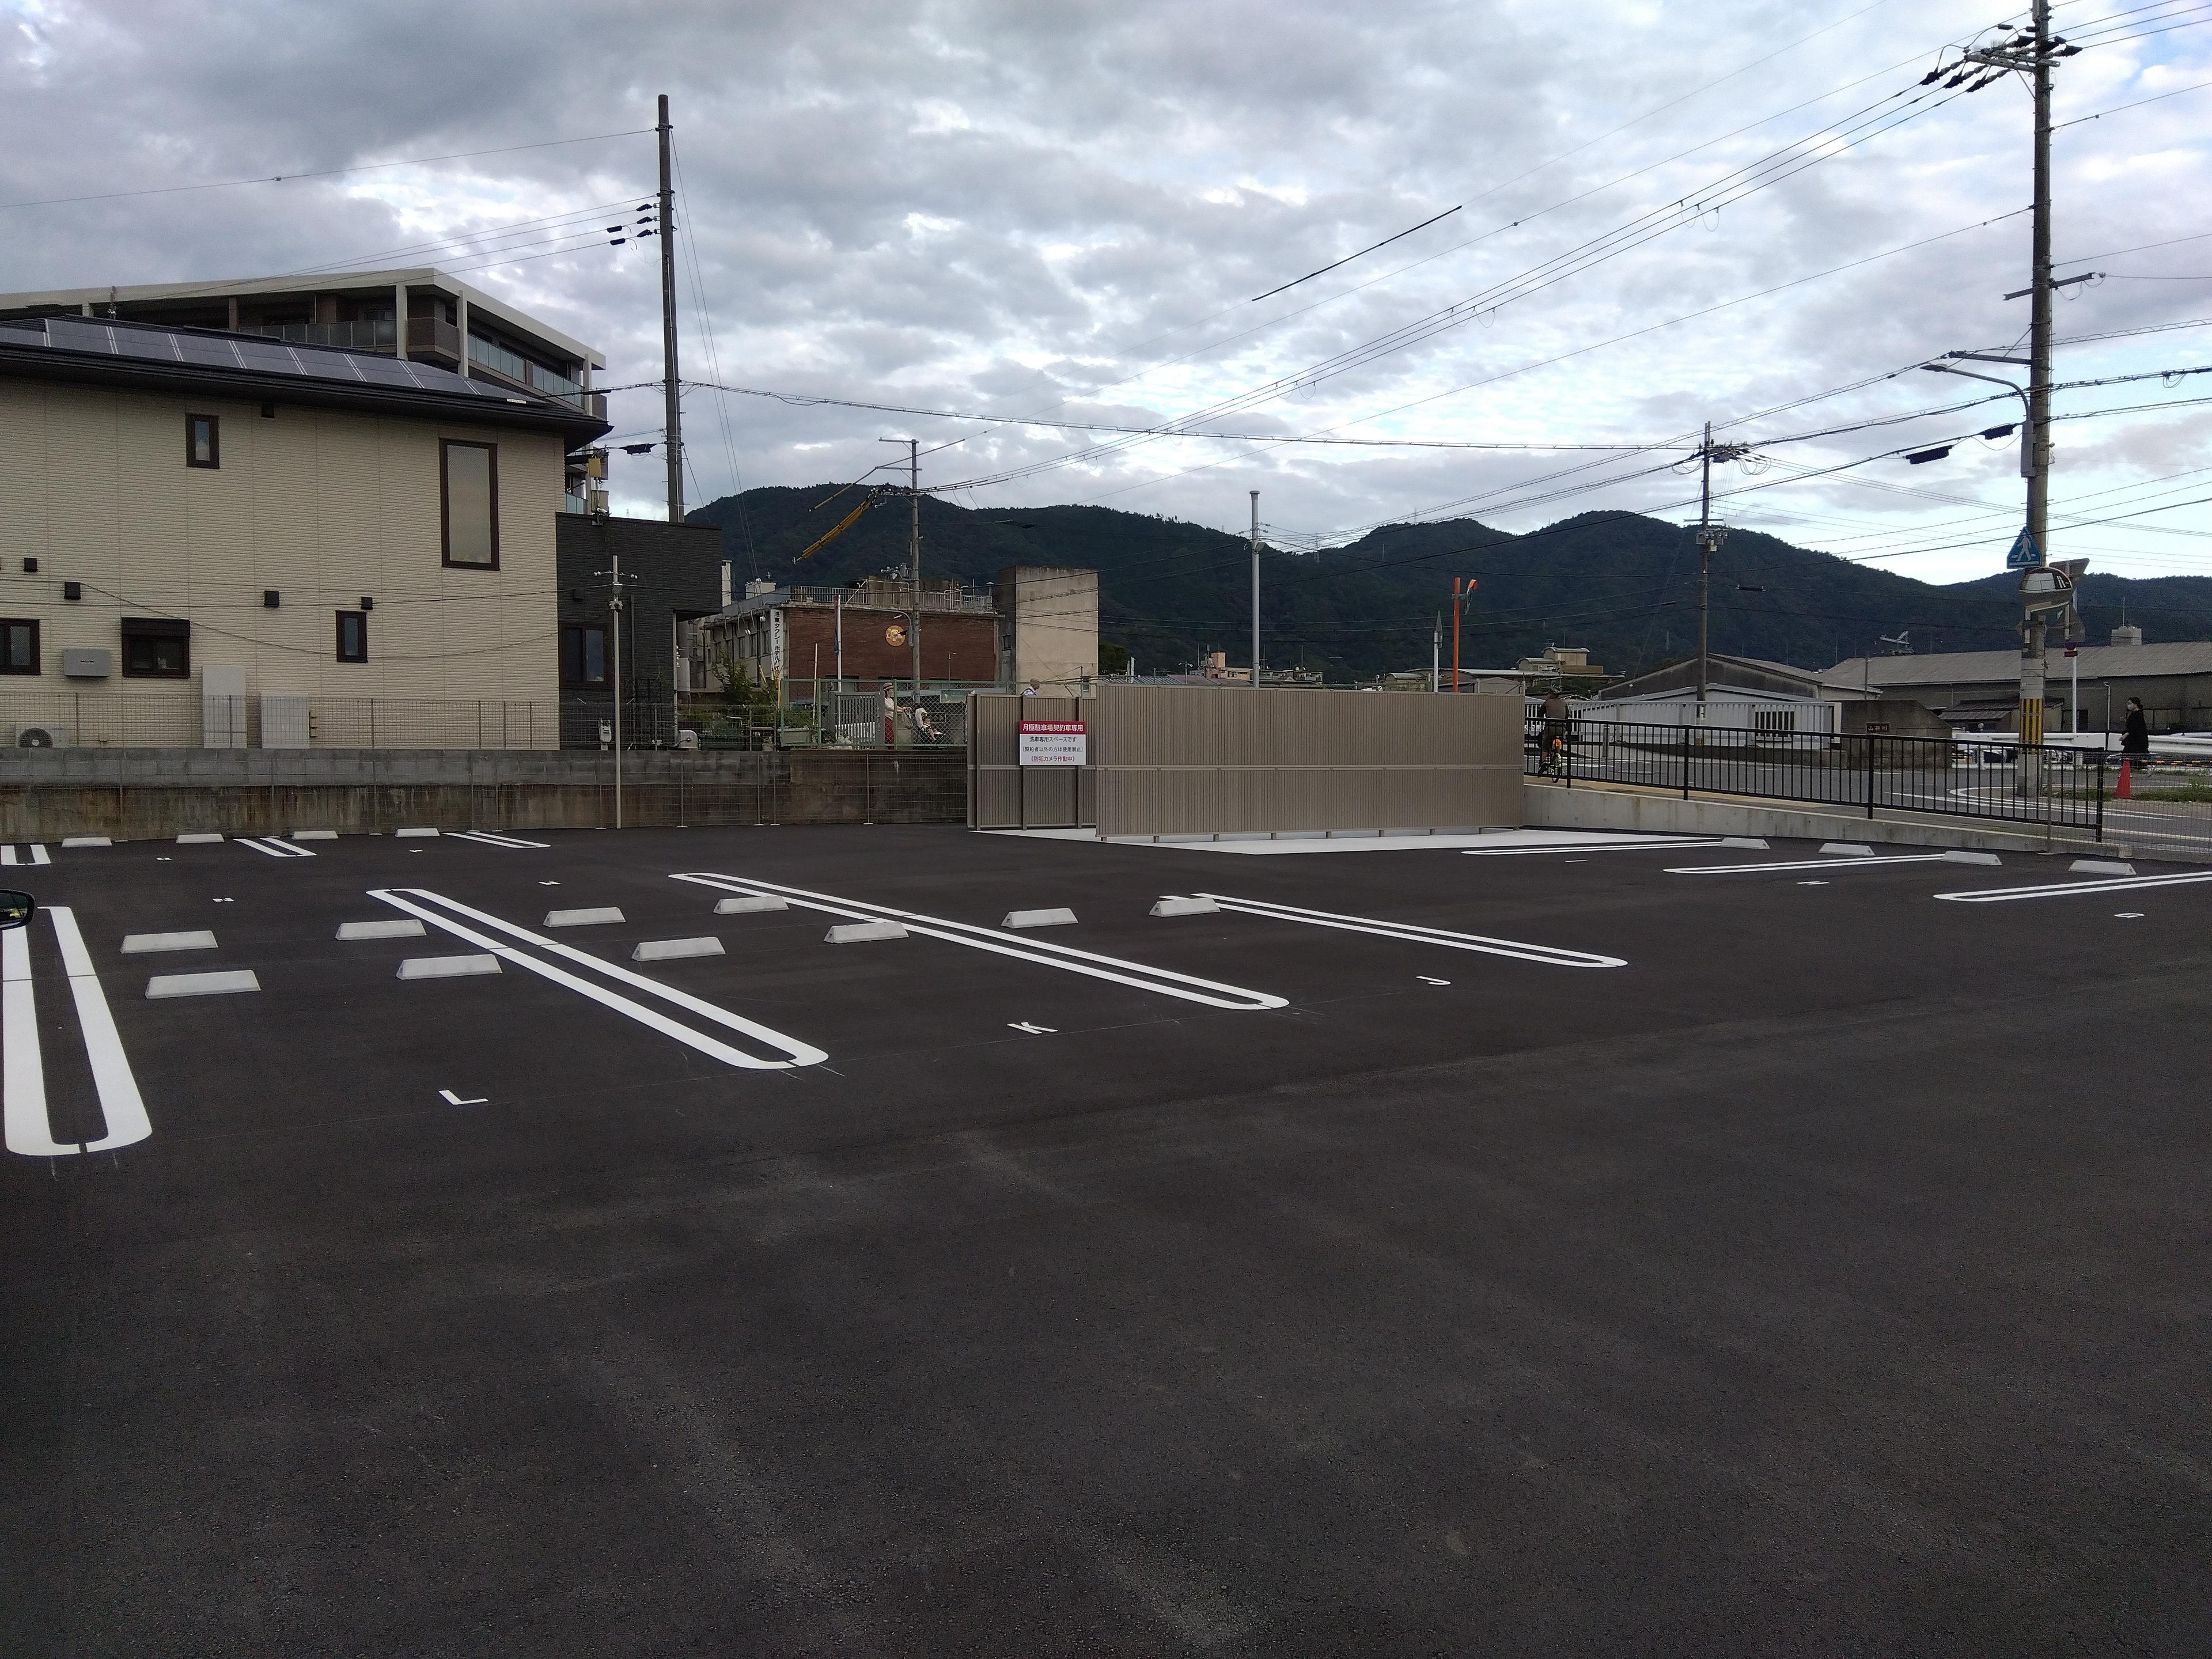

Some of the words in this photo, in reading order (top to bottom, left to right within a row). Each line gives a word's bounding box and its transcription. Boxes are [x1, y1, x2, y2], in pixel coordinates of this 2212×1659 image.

[1022, 724, 1084, 732] 月極駐車場契約車専用
[1415, 976, 1451, 986] J
[1007, 1021, 1059, 1035] K
[438, 1089, 488, 1105] L
